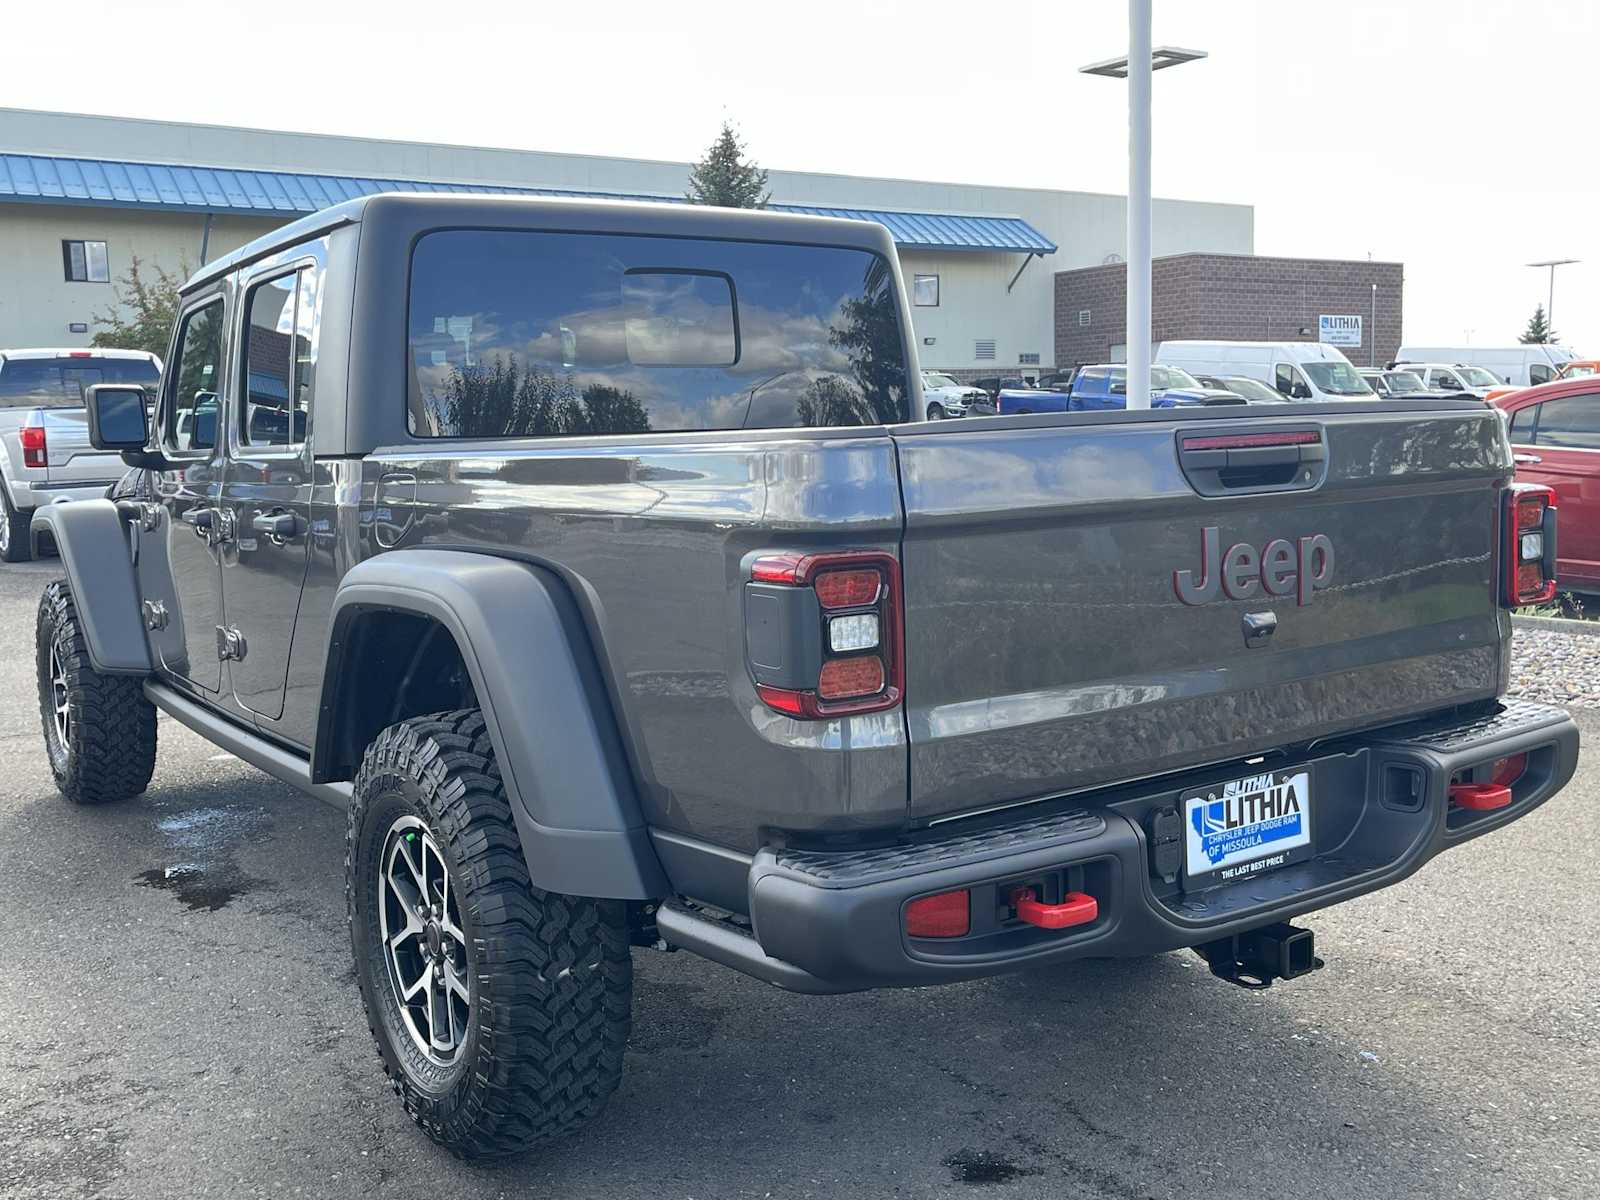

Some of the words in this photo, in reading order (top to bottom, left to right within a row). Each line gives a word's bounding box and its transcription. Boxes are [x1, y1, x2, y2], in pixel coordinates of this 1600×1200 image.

[1330, 317, 1359, 328] LITHIA
[1173, 526, 1335, 607] Jeep
[1234, 774, 1274, 795] LITHIA
[1225, 785, 1300, 830] LITHIA
[1208, 829, 1243, 845] CHRYSLER
[1244, 825, 1260, 837] JEEP
[1260, 820, 1283, 831] DODGE
[1283, 815, 1298, 825] RAM
[1208, 844, 1222, 857] OF
[1221, 834, 1263, 855] MISSOULA
[1221, 870, 1234, 879] THE
[1235, 864, 1250, 873] LAST
[1250, 860, 1266, 870] BEST
[1266, 855, 1284, 866] PRICE
